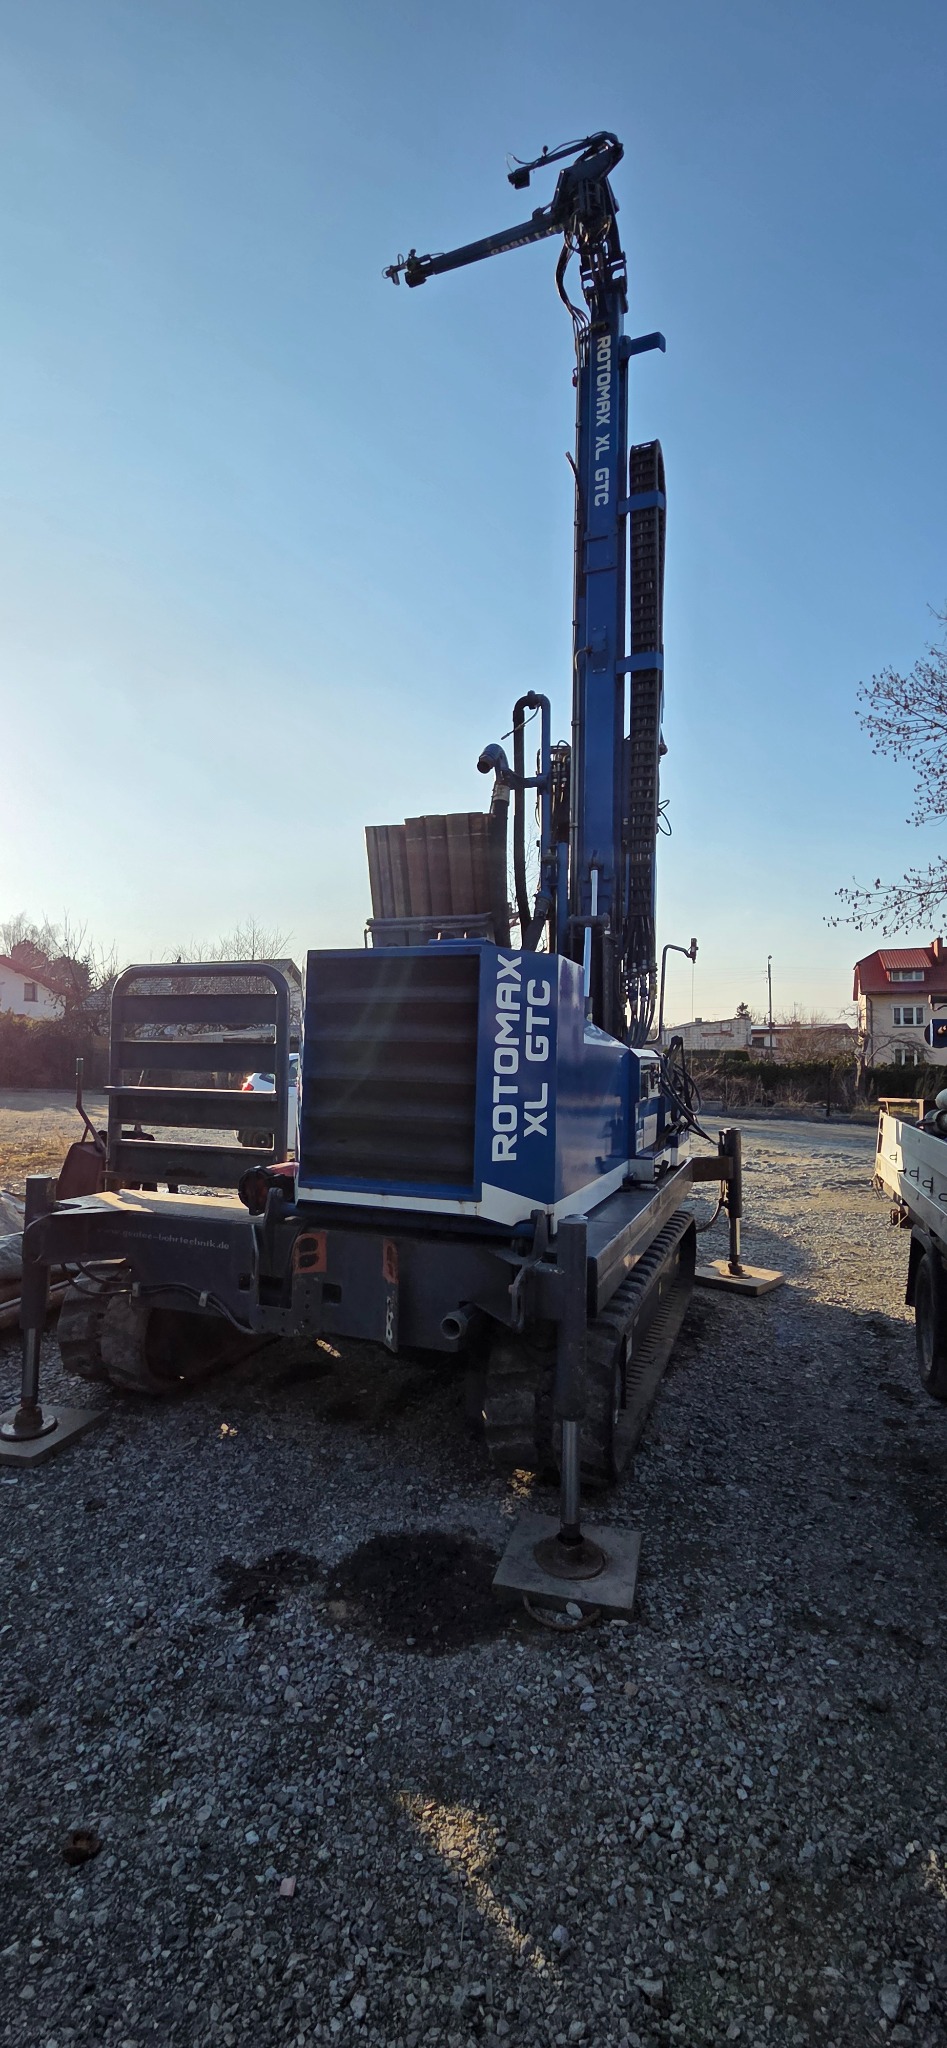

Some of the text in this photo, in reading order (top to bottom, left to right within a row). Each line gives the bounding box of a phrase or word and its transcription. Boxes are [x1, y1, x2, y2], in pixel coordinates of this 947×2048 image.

[594, 334, 612, 507] ROTOMAX XL GTC
[491, 953, 522, 1162] ROTOMAX
[523, 978, 551, 1138] XL GTC
